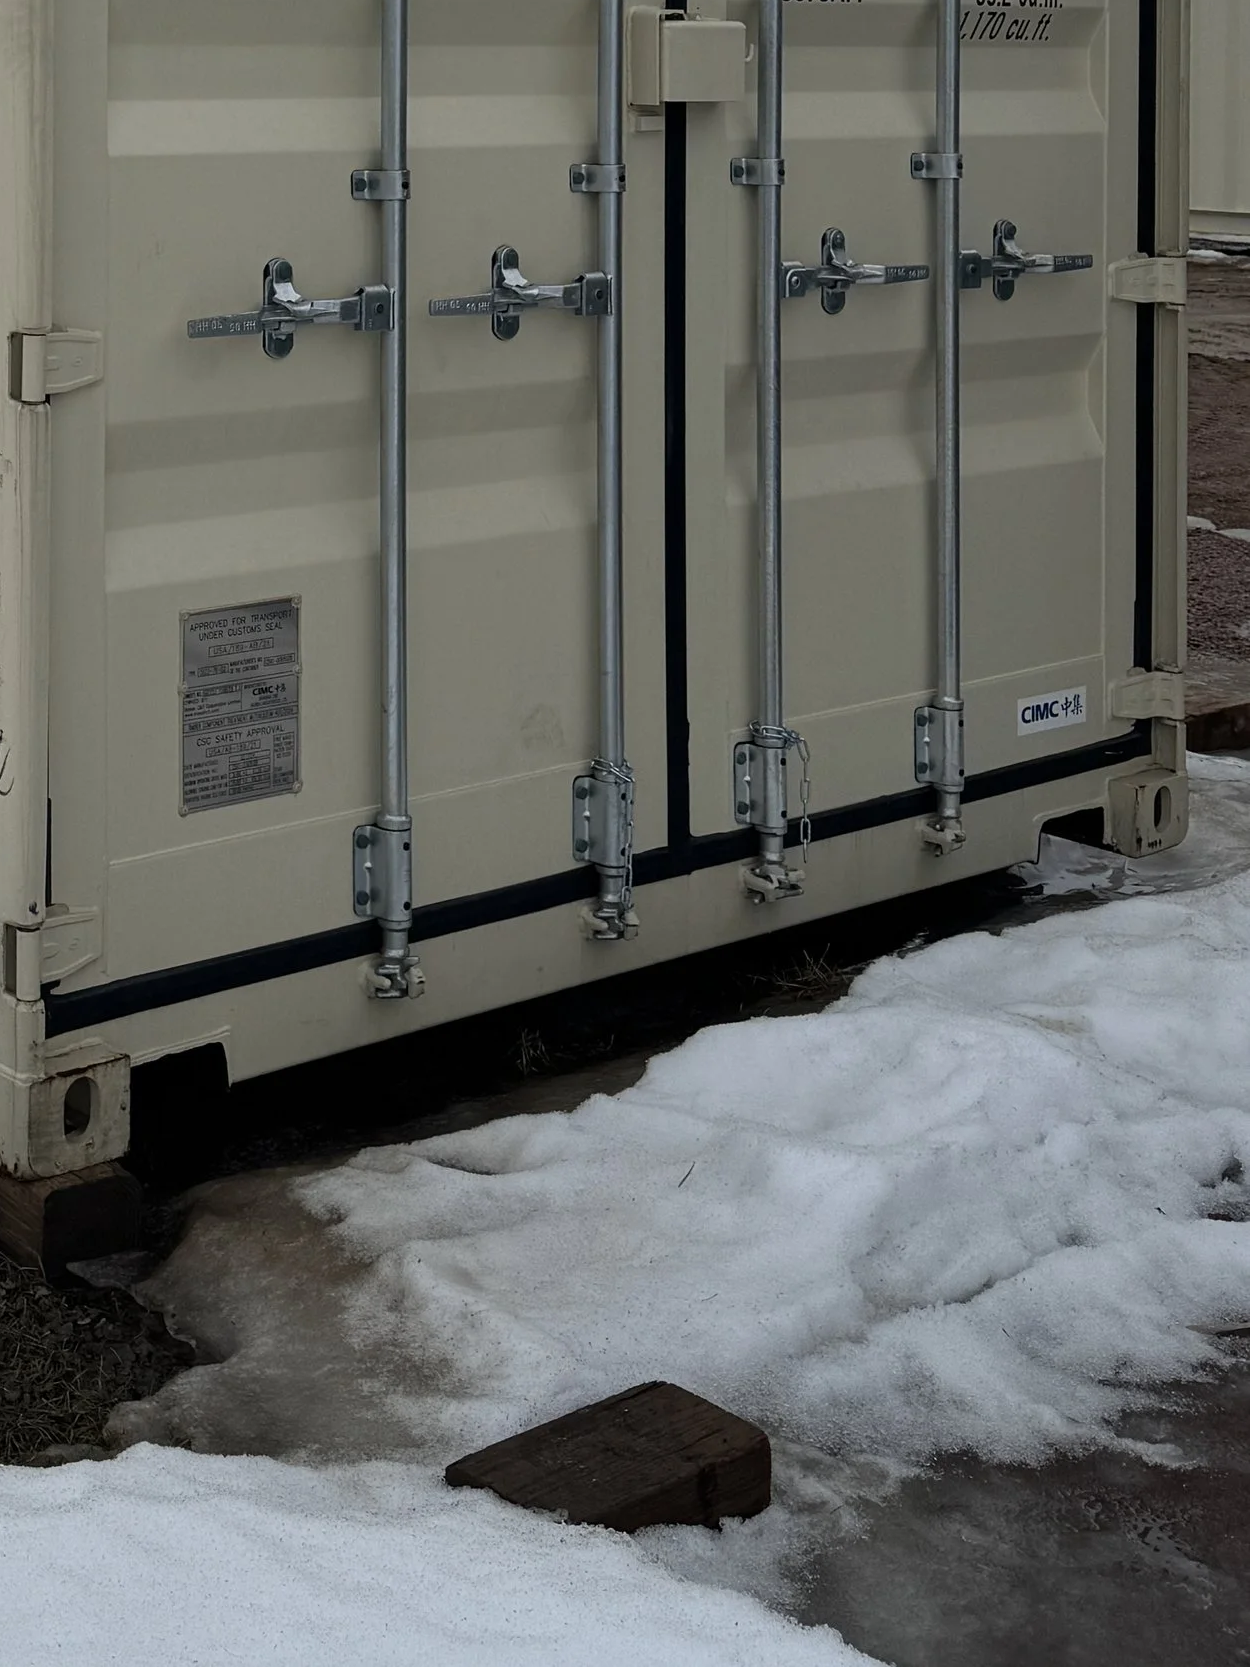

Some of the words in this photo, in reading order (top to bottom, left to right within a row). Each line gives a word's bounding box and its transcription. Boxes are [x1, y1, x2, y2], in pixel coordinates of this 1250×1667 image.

[189, 619, 228, 633] APPROVED
[232, 616, 247, 626] FOR
[251, 609, 292, 623] TRANSPORT
[198, 630, 224, 642] UNDER
[227, 624, 262, 637] CUSTOMS
[265, 621, 283, 632] SEAL
[252, 685, 274, 696] CIMC
[1021, 700, 1059, 724] CIMC
[196, 737, 212, 747] CSC
[215, 731, 242, 744] SAFETY
[246, 725, 285, 738] APPROVAL
